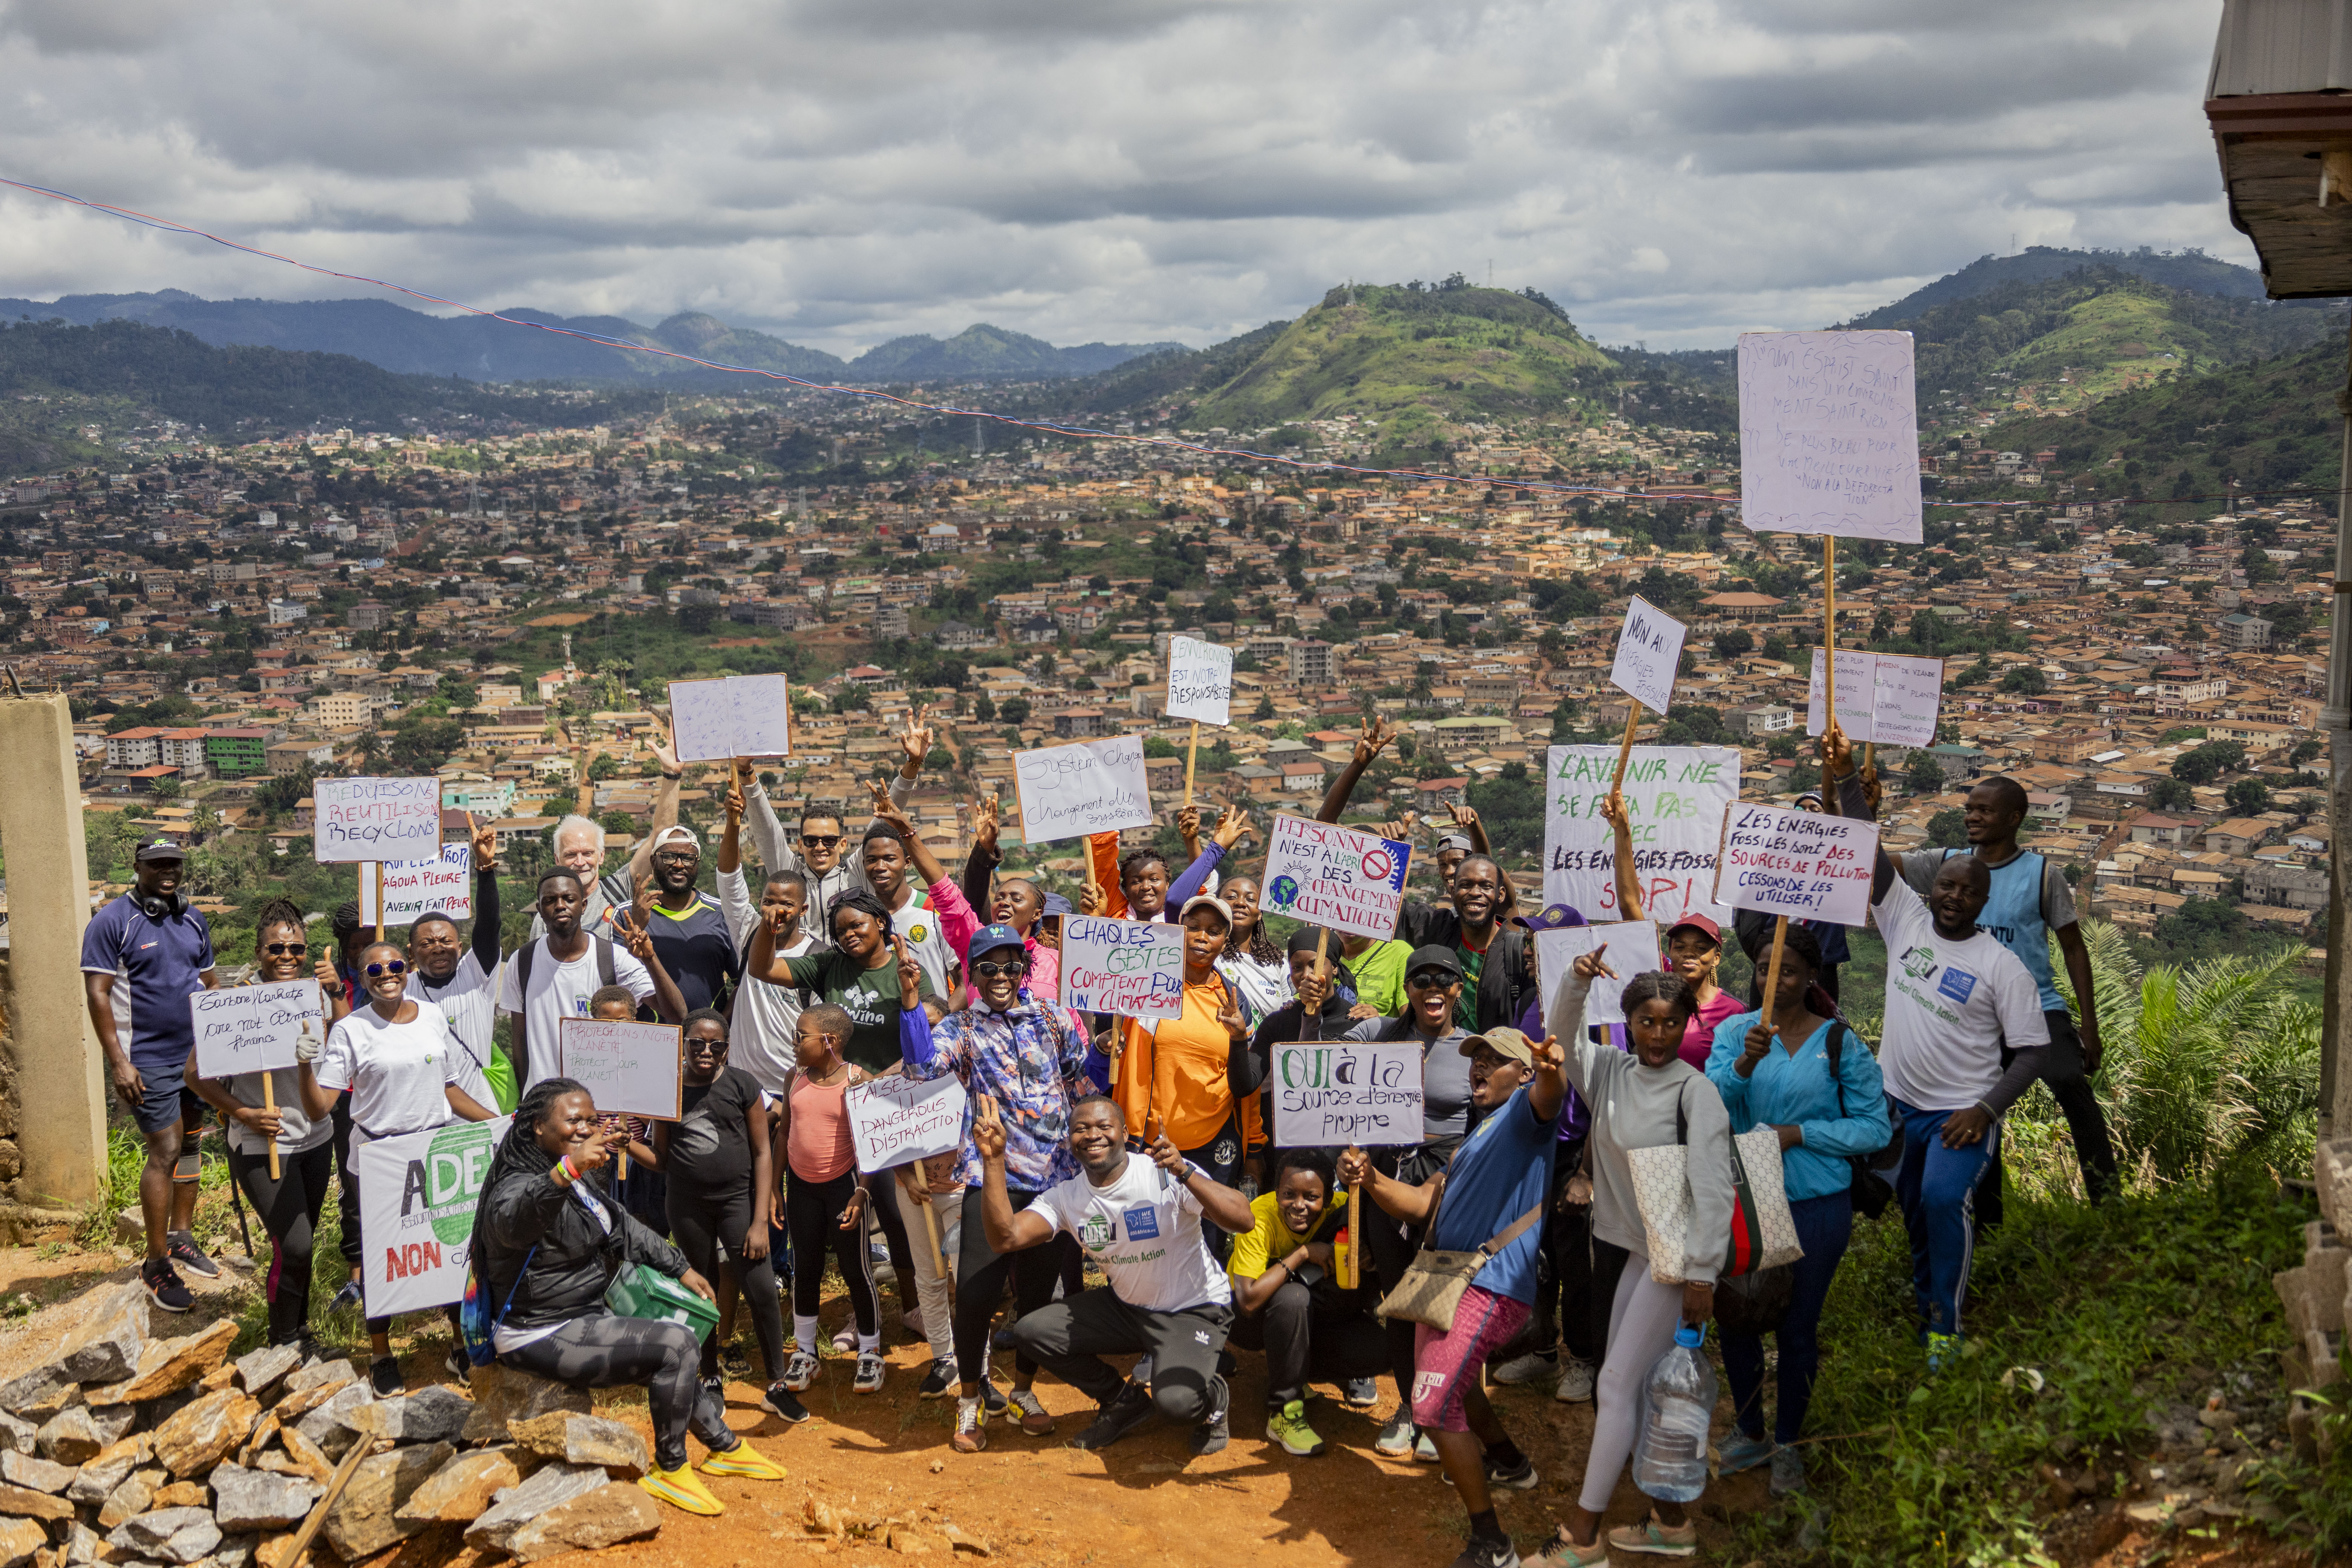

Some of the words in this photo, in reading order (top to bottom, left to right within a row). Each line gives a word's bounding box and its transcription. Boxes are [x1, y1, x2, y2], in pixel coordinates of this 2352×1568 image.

[1787, 375, 1818, 394] DANS
[1772, 397, 1814, 414] MENT
[1816, 399, 1857, 420] SAINT
[1776, 423, 1793, 447] DE
[1802, 434, 1827, 452] PLUS
[1627, 613, 1651, 645] NON
[1651, 631, 1673, 657] AUX
[1619, 642, 1654, 677] ENERGIES
[1816, 653, 1845, 663] MGER
[1173, 670, 1188, 682] EST
[1193, 668, 1218, 683] NOTRE
[1815, 665, 1864, 677] DILGEMMENT
[1912, 669, 1936, 677] VIANDE
[1635, 680, 1668, 708] FOSSILES
[1814, 694, 1847, 703] PROGER
[1836, 684, 1858, 692] AUSSI
[1910, 690, 1938, 700] PLANTES
[1876, 701, 1901, 710] VIVONS
[1019, 753, 1097, 789] System
[1678, 761, 1723, 783] NE
[325, 780, 433, 801] REDUISONS
[1027, 797, 1102, 825] Changement
[1558, 794, 1581, 818] SE
[1654, 792, 1697, 819] PAS
[327, 820, 434, 844] RECYCLONS
[1603, 825, 1657, 844] AEC
[1737, 809, 1771, 828] LES
[1777, 816, 1849, 838] ENERGIES
[1278, 818, 1372, 854] PERSONNE
[1730, 831, 1787, 849] FOSSILES
[1789, 841, 1825, 854] sont
[1826, 844, 1854, 860] DES
[1279, 839, 1318, 858] N'EST
[1321, 845, 1332, 863] À
[1553, 845, 1583, 871] LES
[1589, 850, 1667, 872] ENGIES
[1323, 865, 1351, 884] DES
[1730, 849, 1790, 869] SOURCES
[1792, 861, 1809, 873] DE
[1816, 861, 1872, 880] POLLUTION
[383, 874, 418, 889] AGOUA
[422, 871, 461, 887] PLEURE
[1740, 872, 1785, 887] CESSONS
[1786, 878, 1805, 891] DE
[1810, 881, 1834, 892] LES
[446, 896, 470, 910] PEUR
[1297, 896, 1392, 930] CLIMATIQUES
[1069, 920, 1155, 947] CHAQUES
[1107, 947, 1181, 974] GESTES
[1560, 939, 1588, 962] FOR
[1070, 967, 1149, 993] COMPTENT
[1150, 972, 1182, 1000] POUR
[196, 992, 250, 1011] Carbone
[252, 988, 303, 1005] Markets
[1070, 989, 1088, 1009] UN
[1150, 993, 1181, 1010] SAINT
[1912, 988, 1935, 1012] Climate
[1936, 1006, 1959, 1025] Action
[227, 1035, 277, 1052] finance
[567, 1020, 638, 1039] PROTEGEONS
[643, 1030, 679, 1044] NOTRE
[567, 1053, 608, 1067] PROTECT
[619, 1060, 638, 1069] OUR
[1282, 1049, 1333, 1089] OUI
[1335, 1048, 1356, 1084] à
[571, 1068, 614, 1081] PLANET
[850, 1077, 902, 1110] FALSE
[861, 1098, 946, 1138] DANGEROUS
[1323, 1112, 1389, 1138] propre
[401, 1143, 498, 1217] ADE
[446, 1202, 469, 1217] ACTEURS
[470, 1200, 476, 1211] DE
[386, 1241, 441, 1282] NON
[1111, 1254, 1139, 1265] Climate
[1141, 1248, 1165, 1262] Action
[1427, 1375, 1445, 1385] CITY
